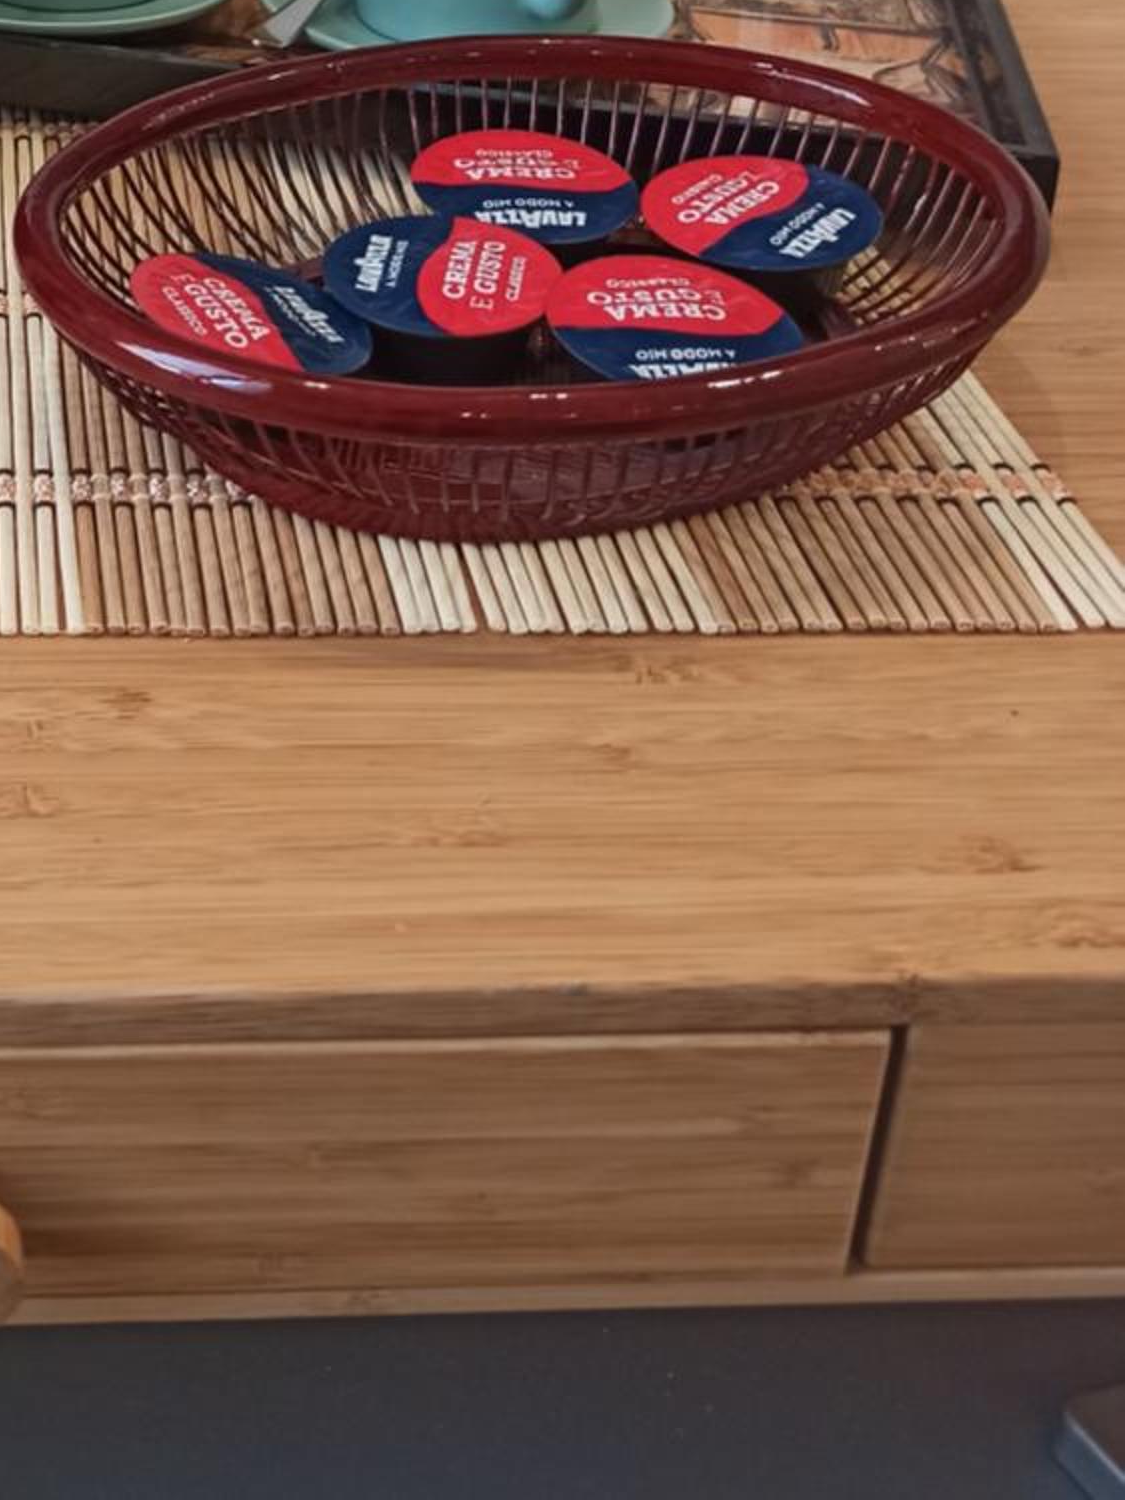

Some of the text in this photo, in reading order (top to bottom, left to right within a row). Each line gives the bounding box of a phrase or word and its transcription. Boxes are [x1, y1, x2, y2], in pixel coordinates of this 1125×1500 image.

[465, 167, 576, 180] CREMA
[475, 209, 586, 228] LAVAZZA
[677, 178, 748, 223] GUSTO
[704, 181, 780, 224] CREMA
[780, 208, 855, 257] LAVAZZA
[353, 235, 393, 293] LAVAZZA
[443, 240, 478, 299] CREMA
[470, 241, 507, 309] E GUSTO
[161, 285, 208, 336] CLASSICO
[185, 283, 249, 349] GUSTO
[203, 277, 271, 340] CREMA
[587, 289, 702, 305] GUSTO
[603, 303, 727, 321] CREMA
[635, 348, 735, 360] A MODO MIO
